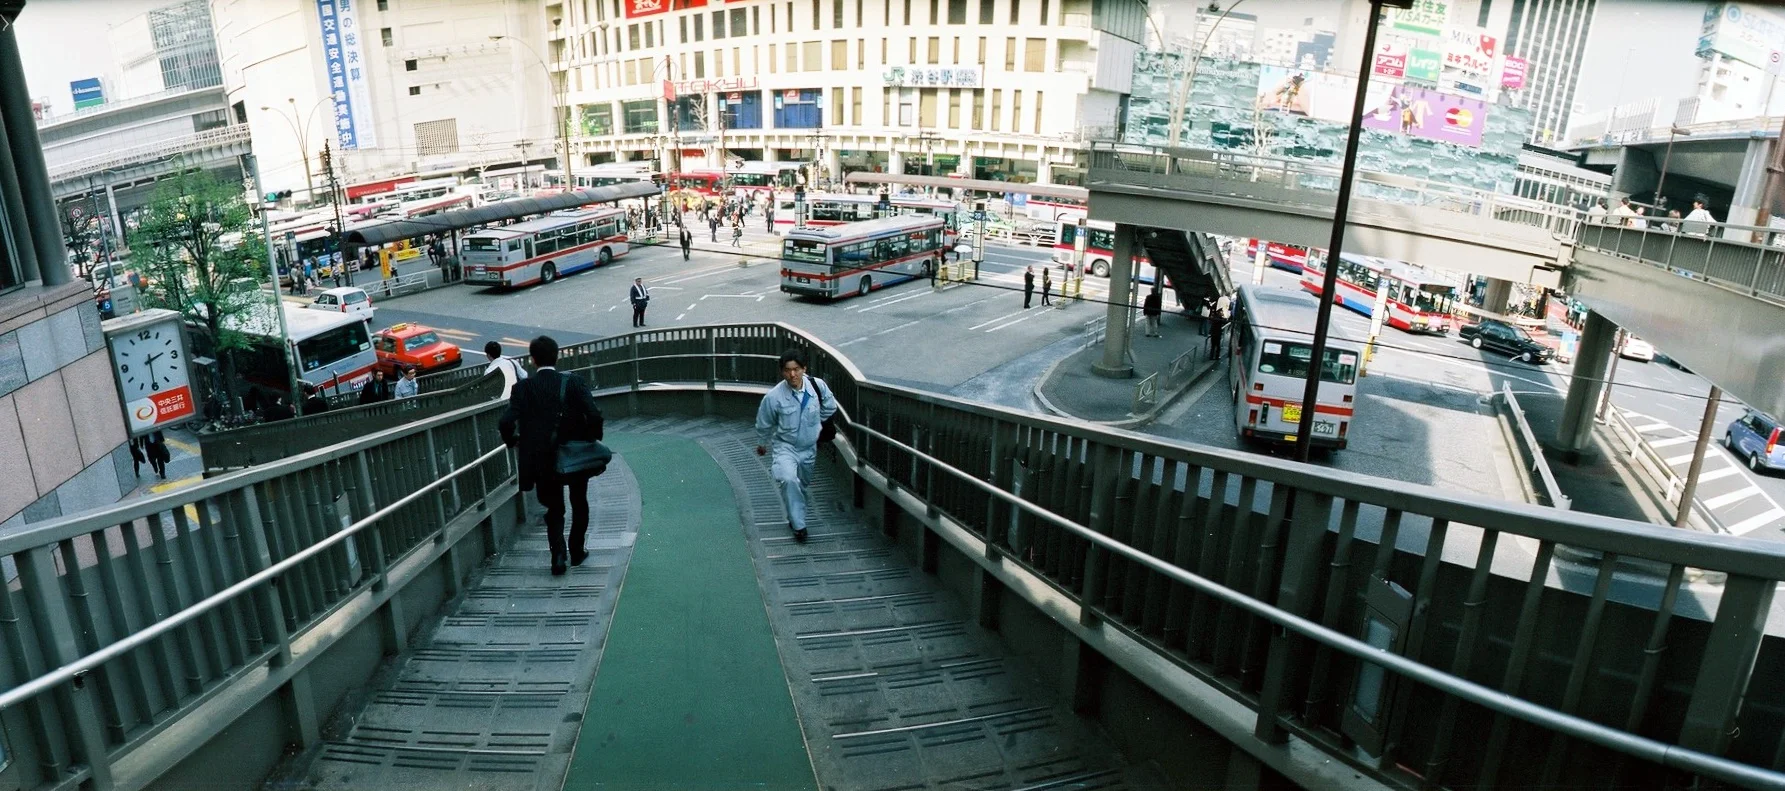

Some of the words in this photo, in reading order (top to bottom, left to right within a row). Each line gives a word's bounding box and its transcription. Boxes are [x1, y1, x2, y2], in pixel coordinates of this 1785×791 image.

[1377, 55, 1404, 68] アコム
[1411, 58, 1438, 71] レイク
[318, 0, 353, 145] 国交通安全運動実施中
[882, 66, 906, 83] JR
[137, 330, 152, 341] 12
[170, 349, 178, 360] 3
[121, 364, 129, 374] 9
[151, 381, 160, 391] 6
[158, 393, 184, 407] 中央三井
[160, 401, 186, 415] 信託銀行
